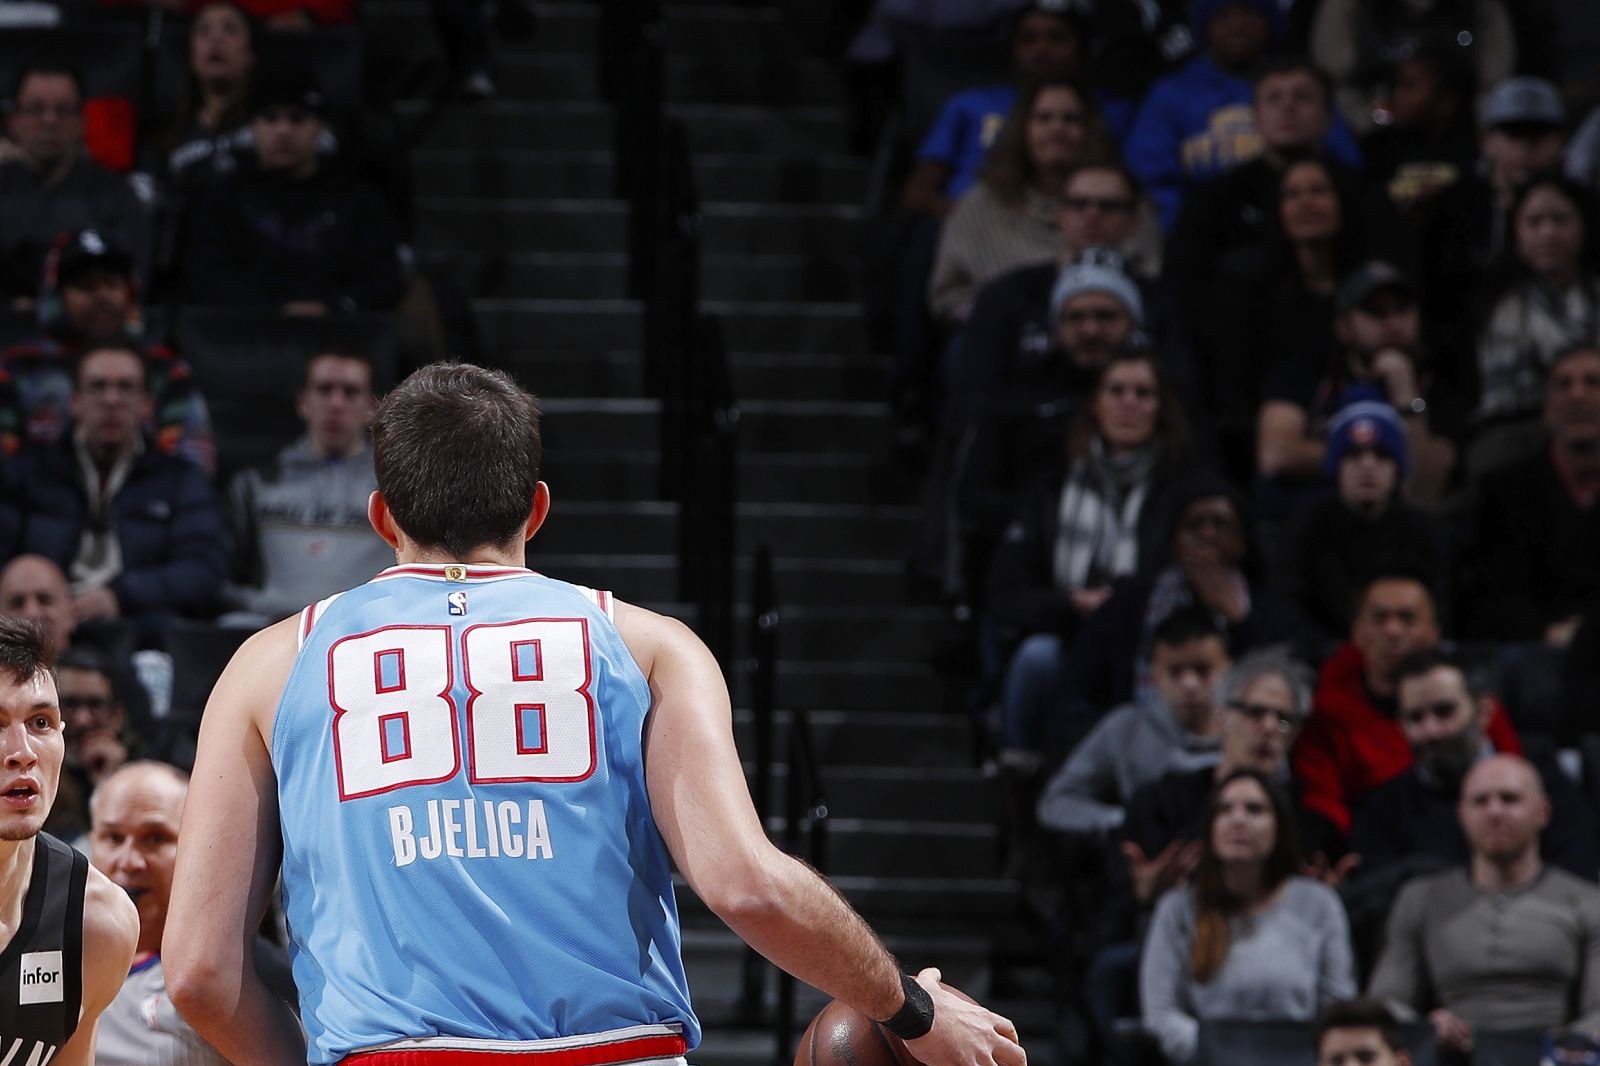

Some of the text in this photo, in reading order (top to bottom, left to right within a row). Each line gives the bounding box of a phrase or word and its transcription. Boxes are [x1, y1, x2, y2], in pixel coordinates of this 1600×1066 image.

[327, 618, 597, 802] 88
[388, 798, 554, 868] BJELICA
[23, 967, 60, 985] infor
